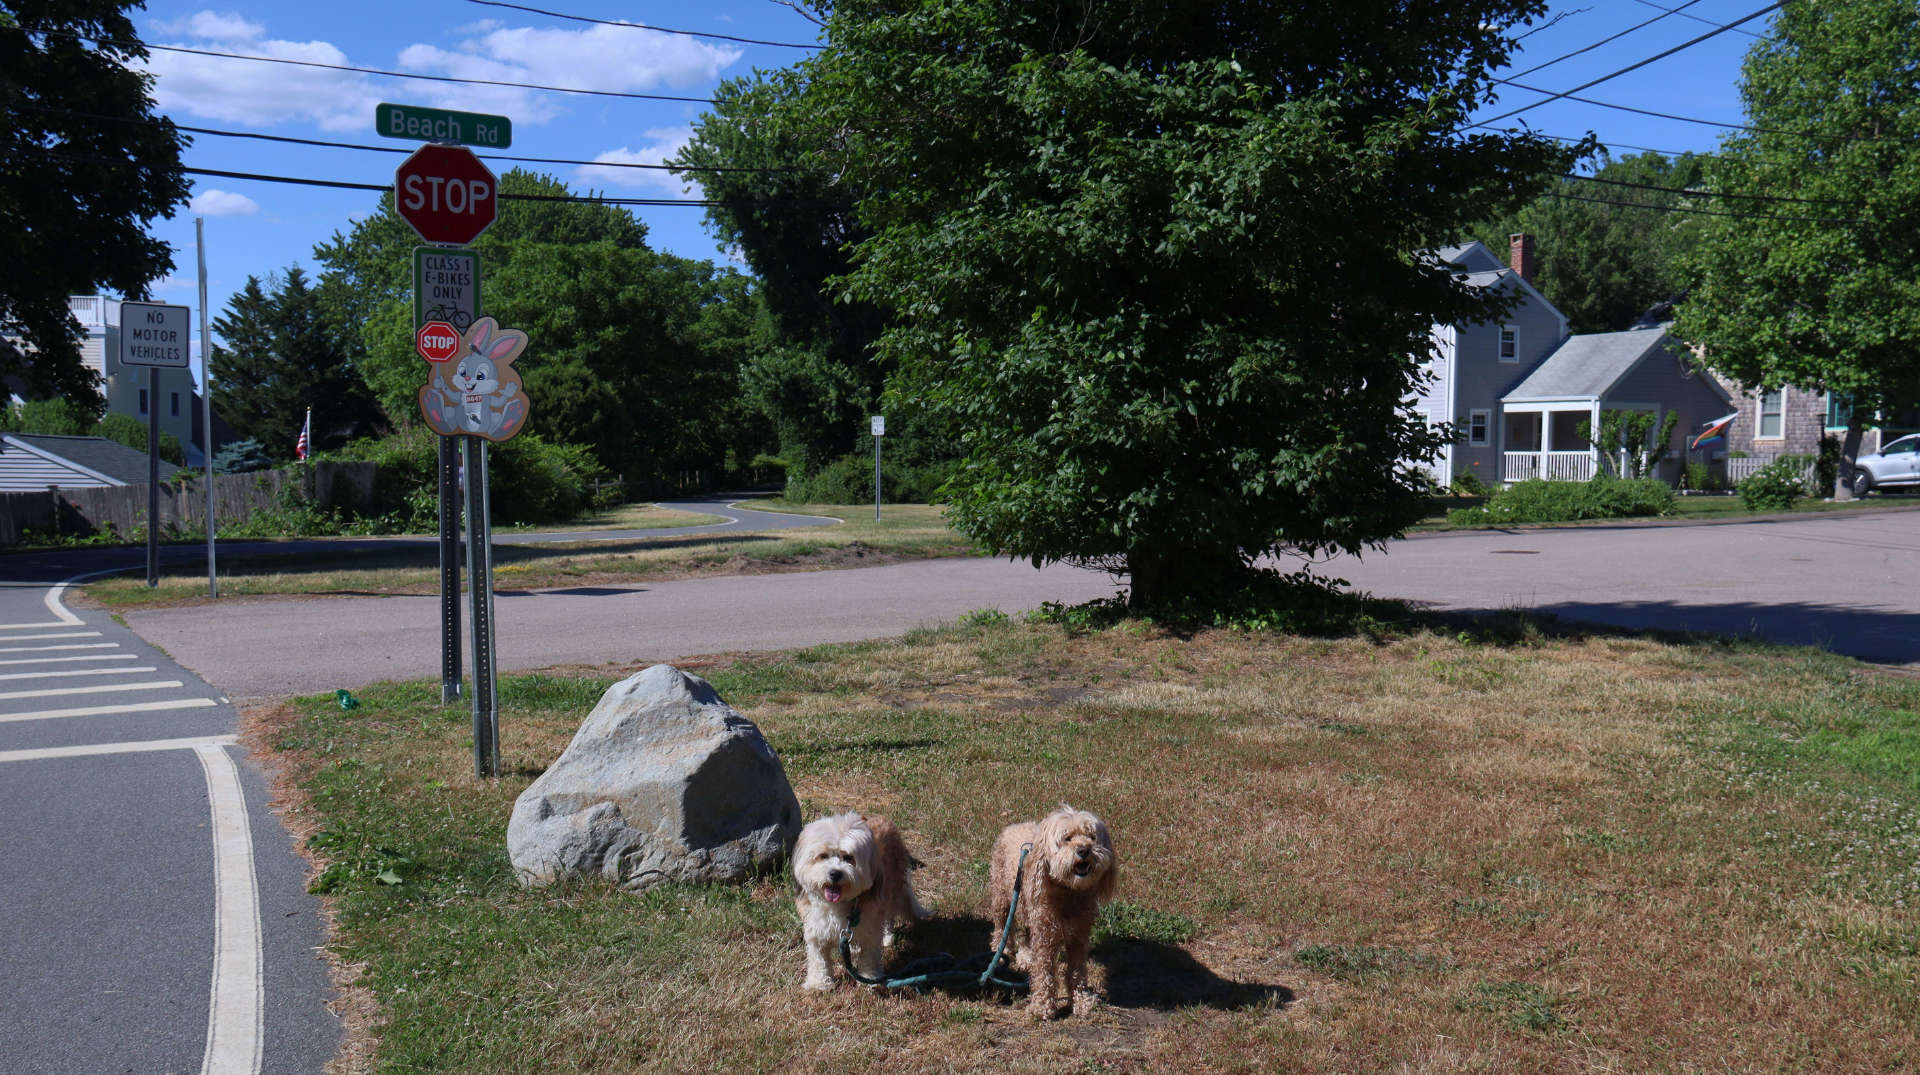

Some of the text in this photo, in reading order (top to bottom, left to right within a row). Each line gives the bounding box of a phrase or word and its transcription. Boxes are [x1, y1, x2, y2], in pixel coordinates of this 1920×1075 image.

[390, 109, 498, 144] Beach Rd
[404, 174, 490, 215] STOP
[426, 256, 470, 272] CLASS 1
[425, 271, 471, 286] E-BIKES
[433, 286, 463, 300] ONLY
[147, 311, 164, 324] NO
[133, 328, 177, 343] MOTOR
[423, 335, 455, 349] STOP
[130, 345, 180, 360] VEHICLES
